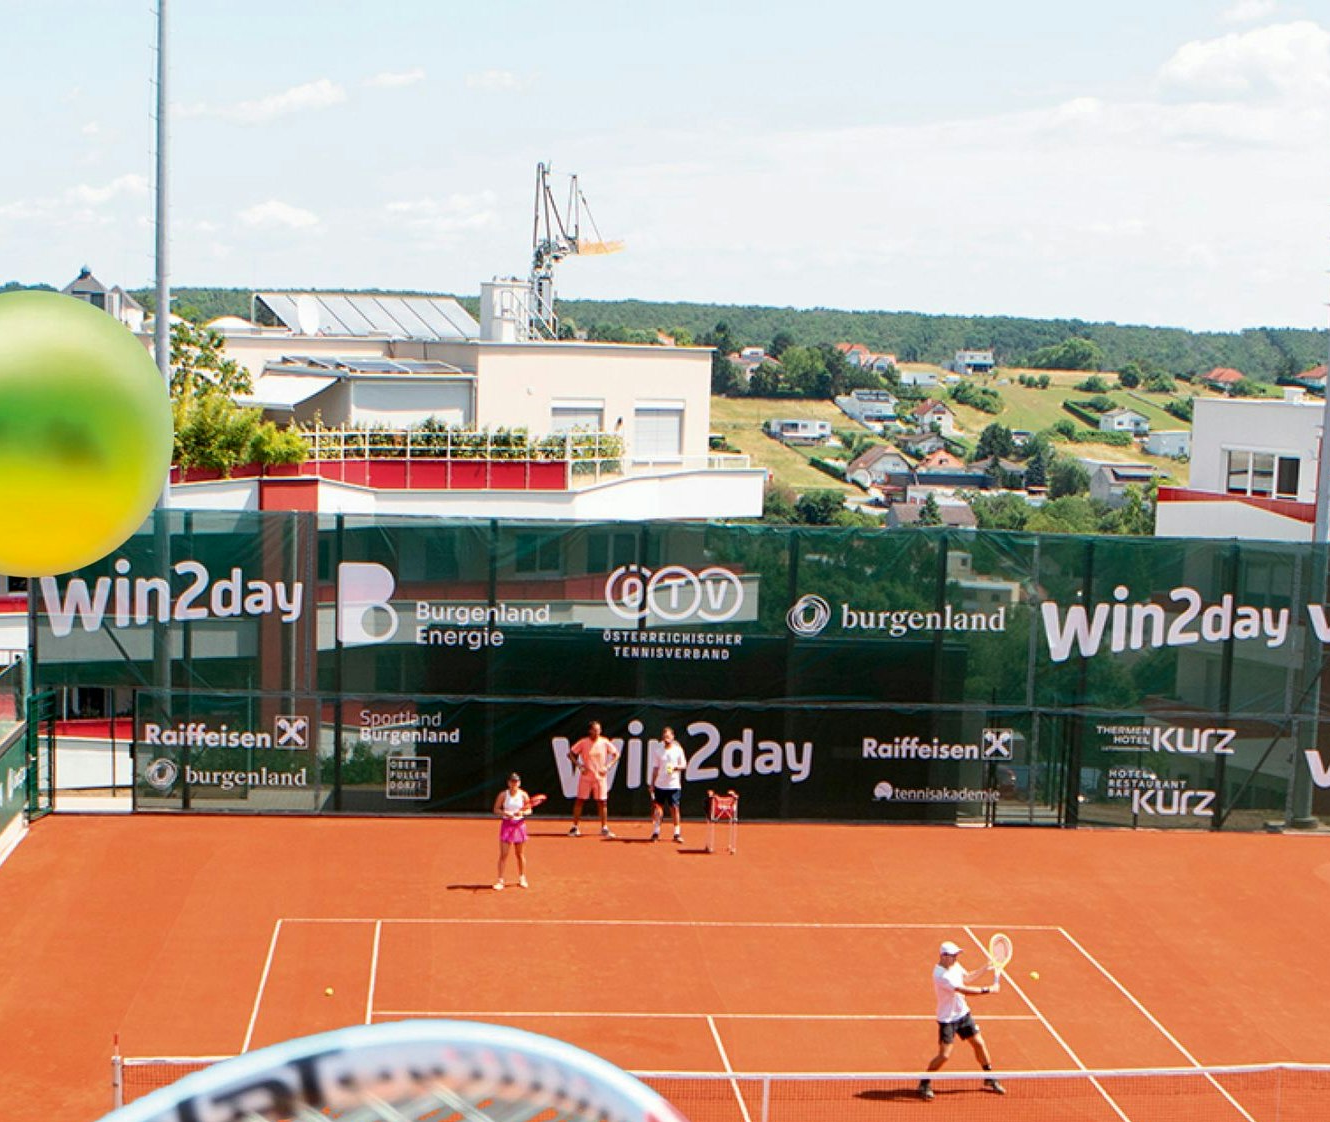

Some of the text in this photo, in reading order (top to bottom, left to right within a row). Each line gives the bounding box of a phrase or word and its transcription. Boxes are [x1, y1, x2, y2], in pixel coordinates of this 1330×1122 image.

[40, 558, 303, 637] win2day
[415, 601, 550, 625] Burgenland
[841, 603, 1006, 637] burgenland
[1041, 585, 1290, 662] win2day
[415, 626, 504, 650] Energie
[603, 630, 742, 646] ÖSTERREICHISCHER
[614, 646, 730, 660] TENNISVERBAND
[360, 709, 442, 728] Sportland
[144, 723, 271, 749] Raiffeisen
[360, 727, 460, 746] Burgenland
[1096, 726, 1151, 736] THERMEN
[1113, 735, 1150, 746] HOTEL
[862, 736, 979, 760] Raiffeisen
[185, 765, 307, 791] burgenland
[1108, 779, 1187, 789] RESTAURANT
[895, 786, 1001, 801] tennisakademie
[1107, 788, 1132, 798] BAR
